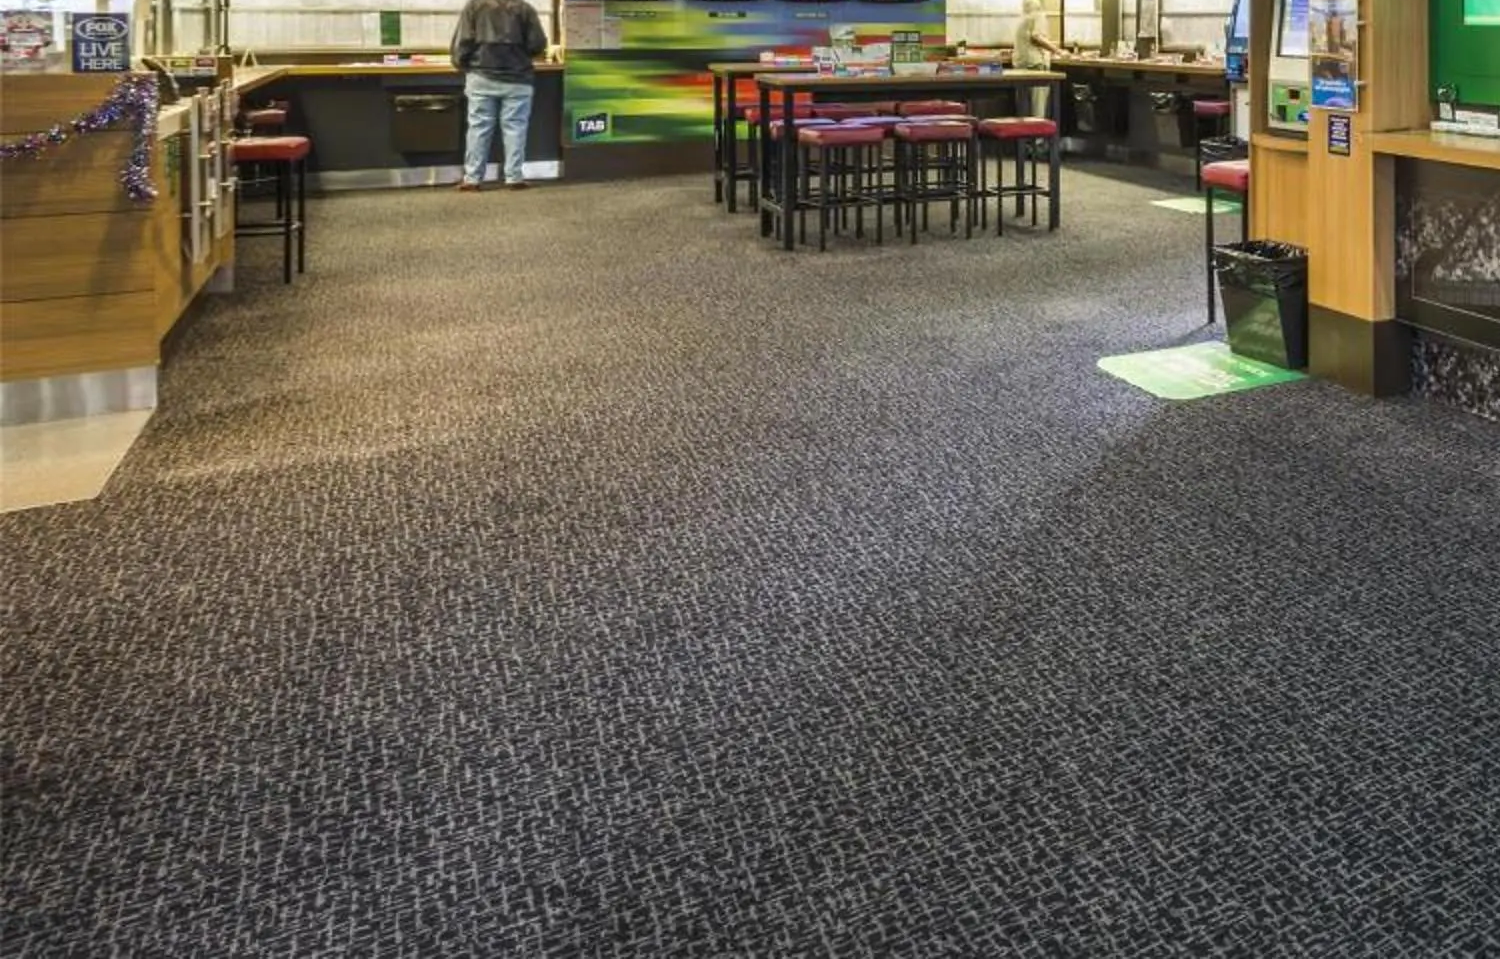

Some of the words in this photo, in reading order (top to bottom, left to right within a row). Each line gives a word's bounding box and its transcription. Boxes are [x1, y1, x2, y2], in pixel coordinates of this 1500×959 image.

[86, 21, 118, 34] FOX
[80, 42, 123, 56] LIVE
[80, 58, 123, 70] HERE
[579, 120, 605, 132] TAB
